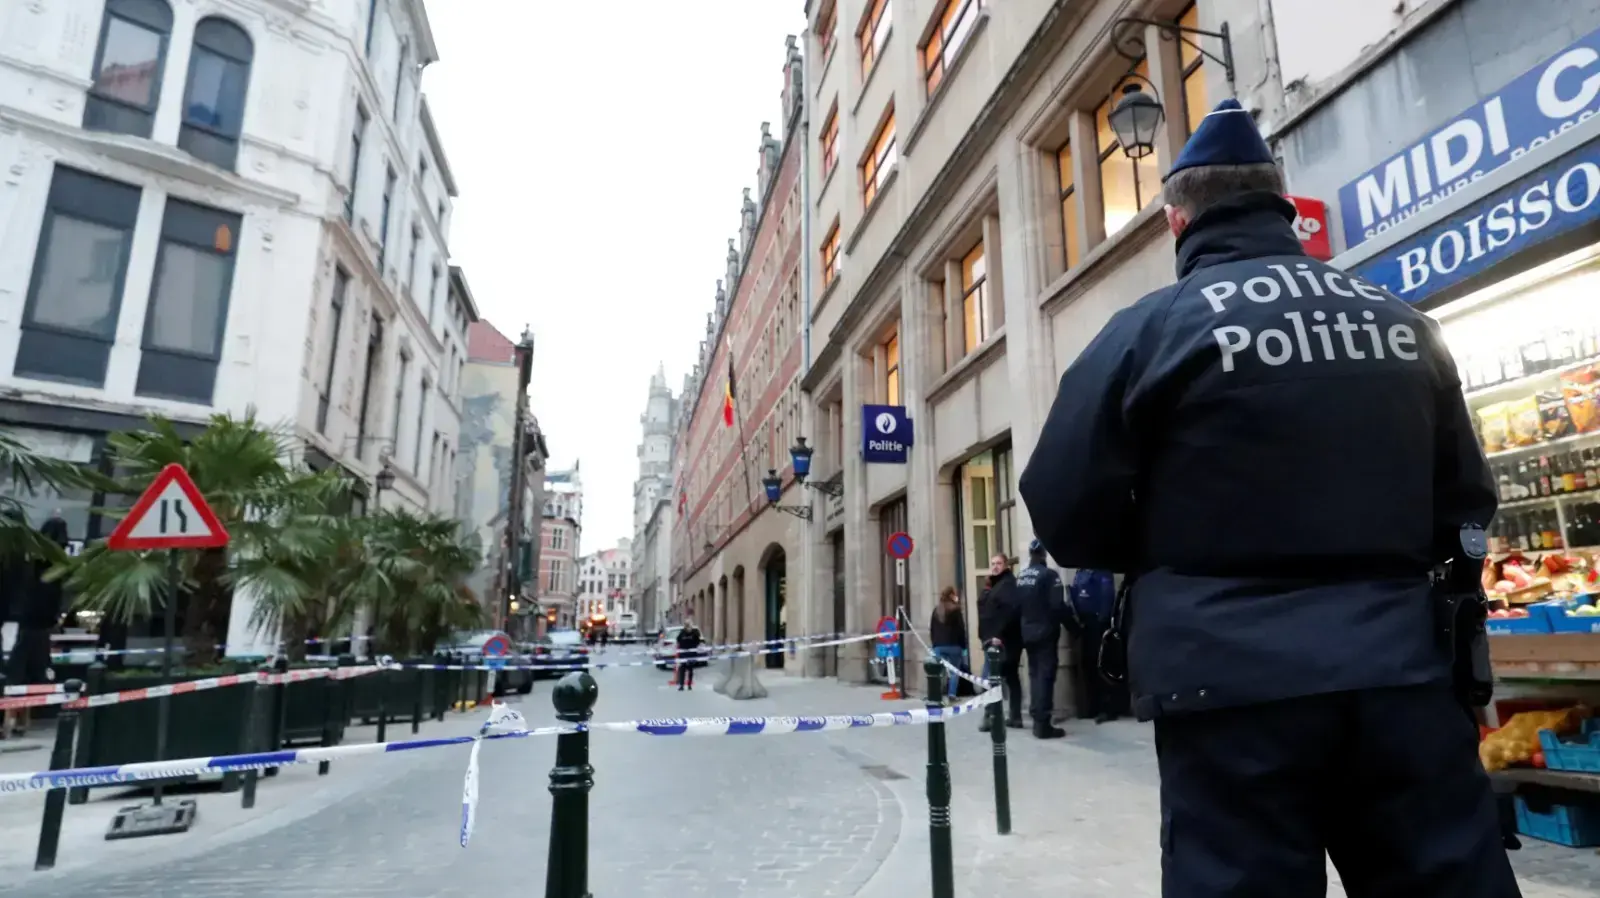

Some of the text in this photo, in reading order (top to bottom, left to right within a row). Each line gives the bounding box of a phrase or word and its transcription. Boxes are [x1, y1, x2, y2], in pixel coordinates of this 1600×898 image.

[1356, 96, 1509, 230] MIDI
[1396, 162, 1600, 293] BOISSO
[1200, 263, 1386, 313] Police
[1212, 310, 1418, 372] Politie
[869, 439, 903, 452] Politie
